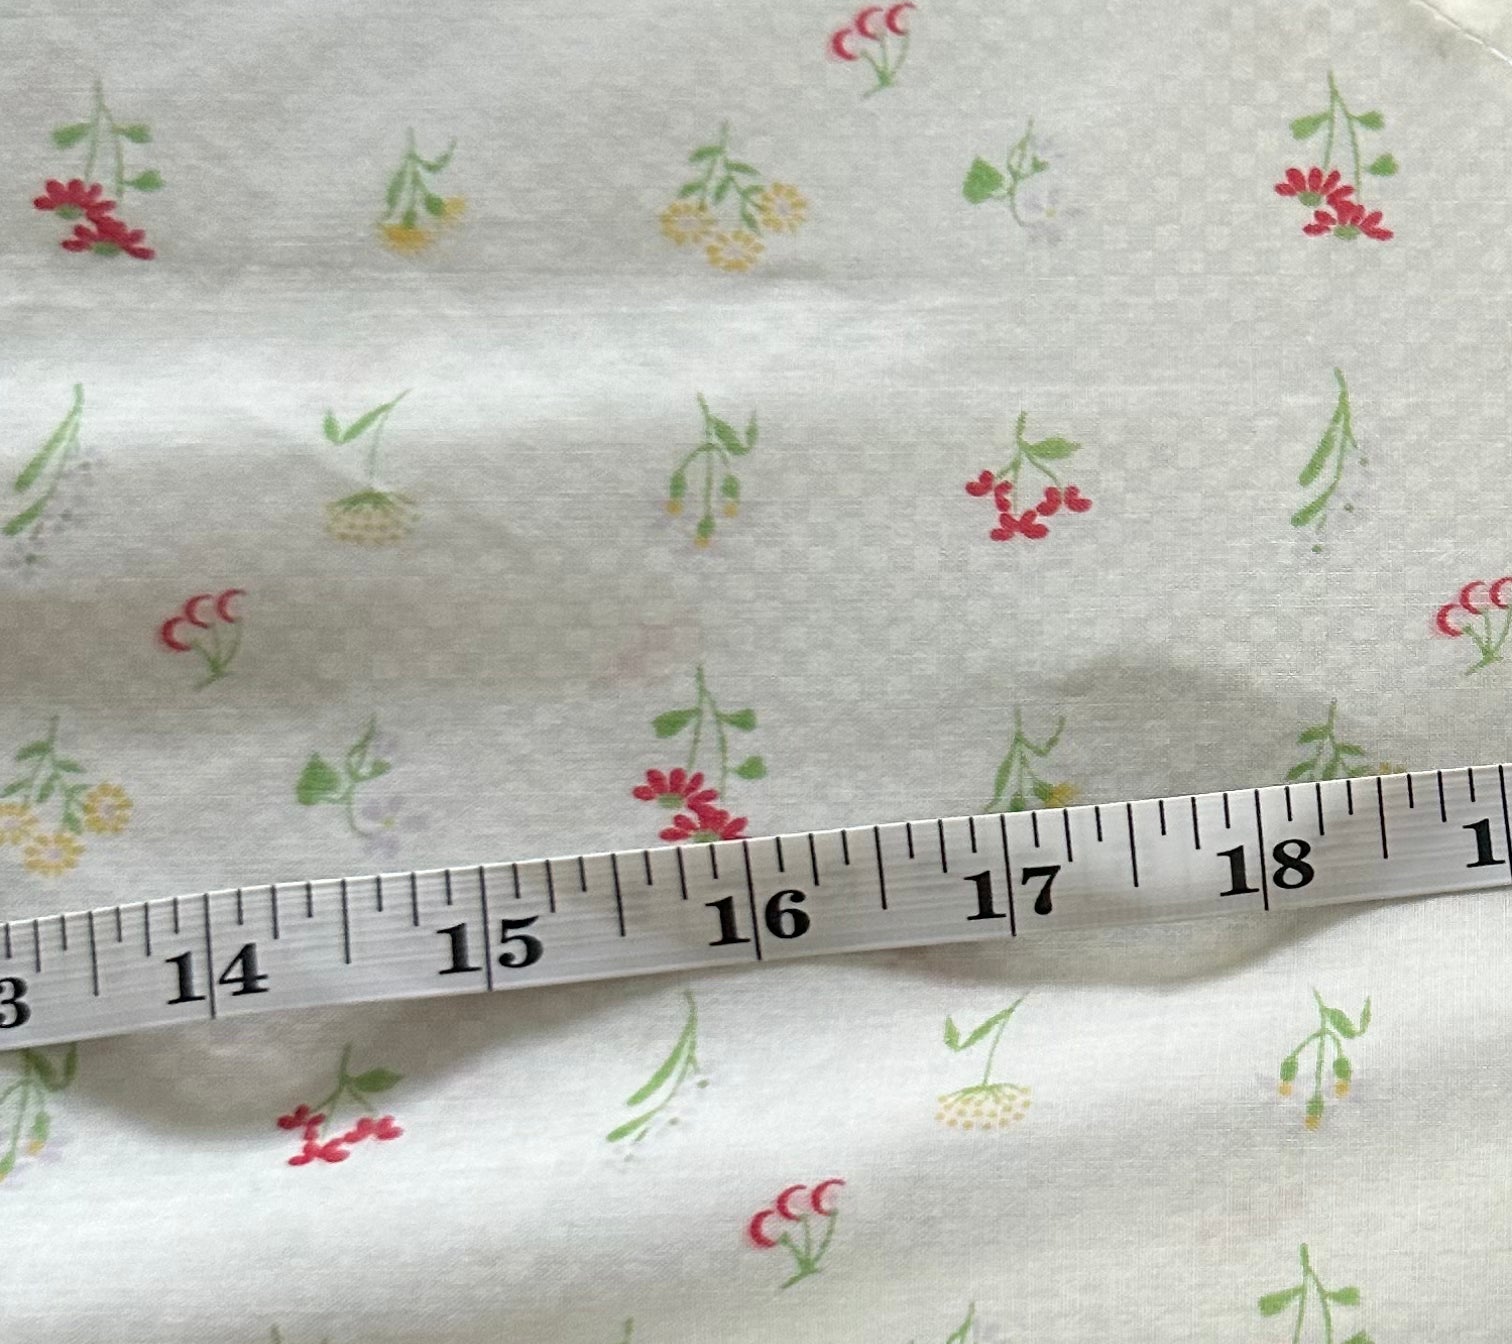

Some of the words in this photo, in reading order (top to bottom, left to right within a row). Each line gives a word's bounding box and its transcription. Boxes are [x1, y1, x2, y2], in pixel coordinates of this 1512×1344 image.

[963, 865, 1061, 921] 17
[1217, 838, 1315, 897] 18
[437, 916, 544, 975] 15
[705, 889, 811, 946] 16
[166, 943, 269, 1004] 14
